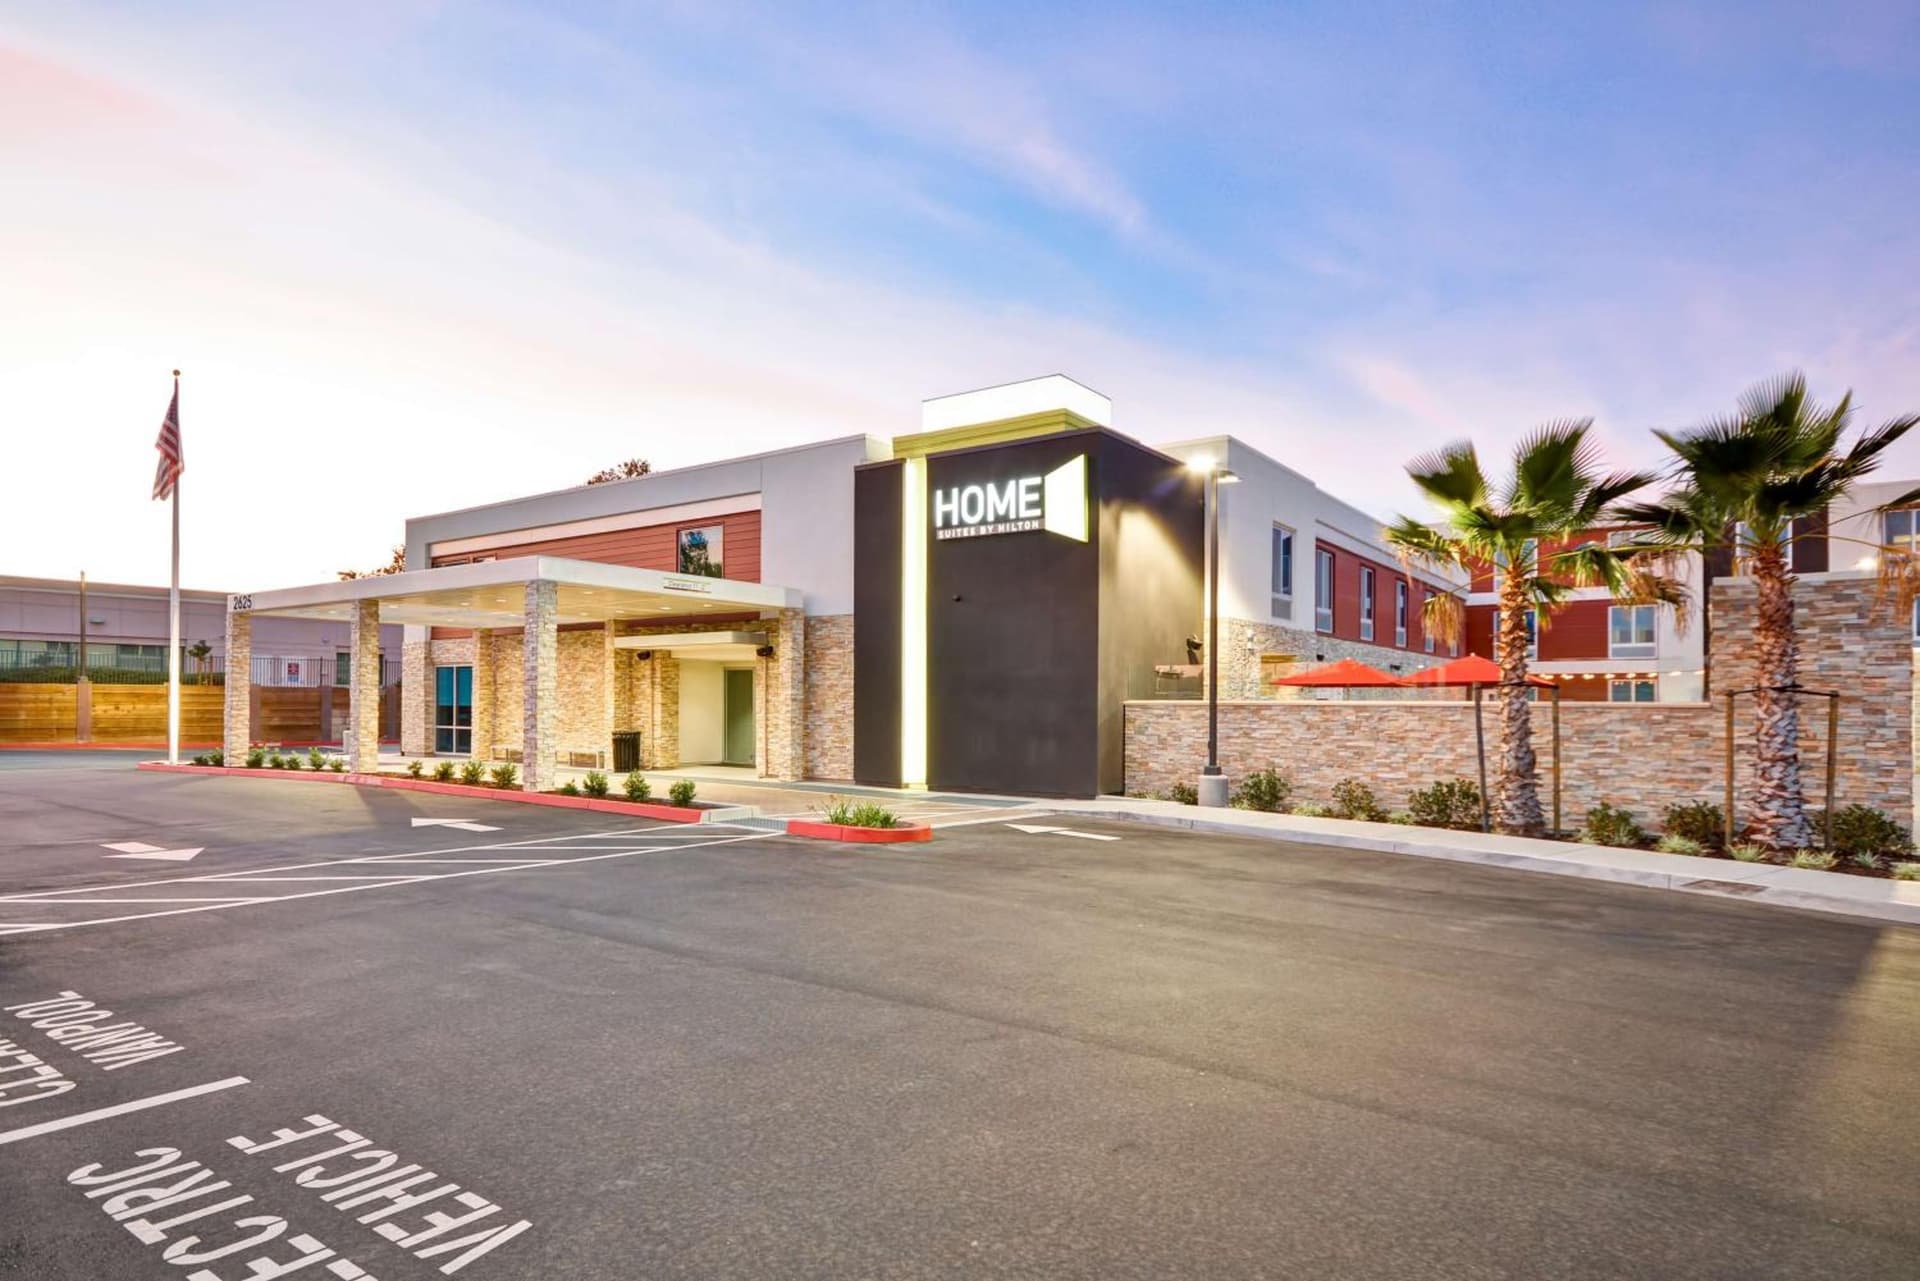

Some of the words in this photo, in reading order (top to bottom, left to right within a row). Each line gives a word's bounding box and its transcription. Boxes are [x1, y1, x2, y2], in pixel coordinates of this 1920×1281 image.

[936, 477, 1042, 528] HOME
[937, 526, 977, 539] SUITES
[979, 523, 995, 536] BY
[998, 519, 1040, 533] HILTON
[233, 595, 252, 610] 2625
[3, 990, 185, 1071] VANPOOL
[67, 1147, 379, 1281] ECTRIC
[225, 1113, 533, 1275] VEHICLE
